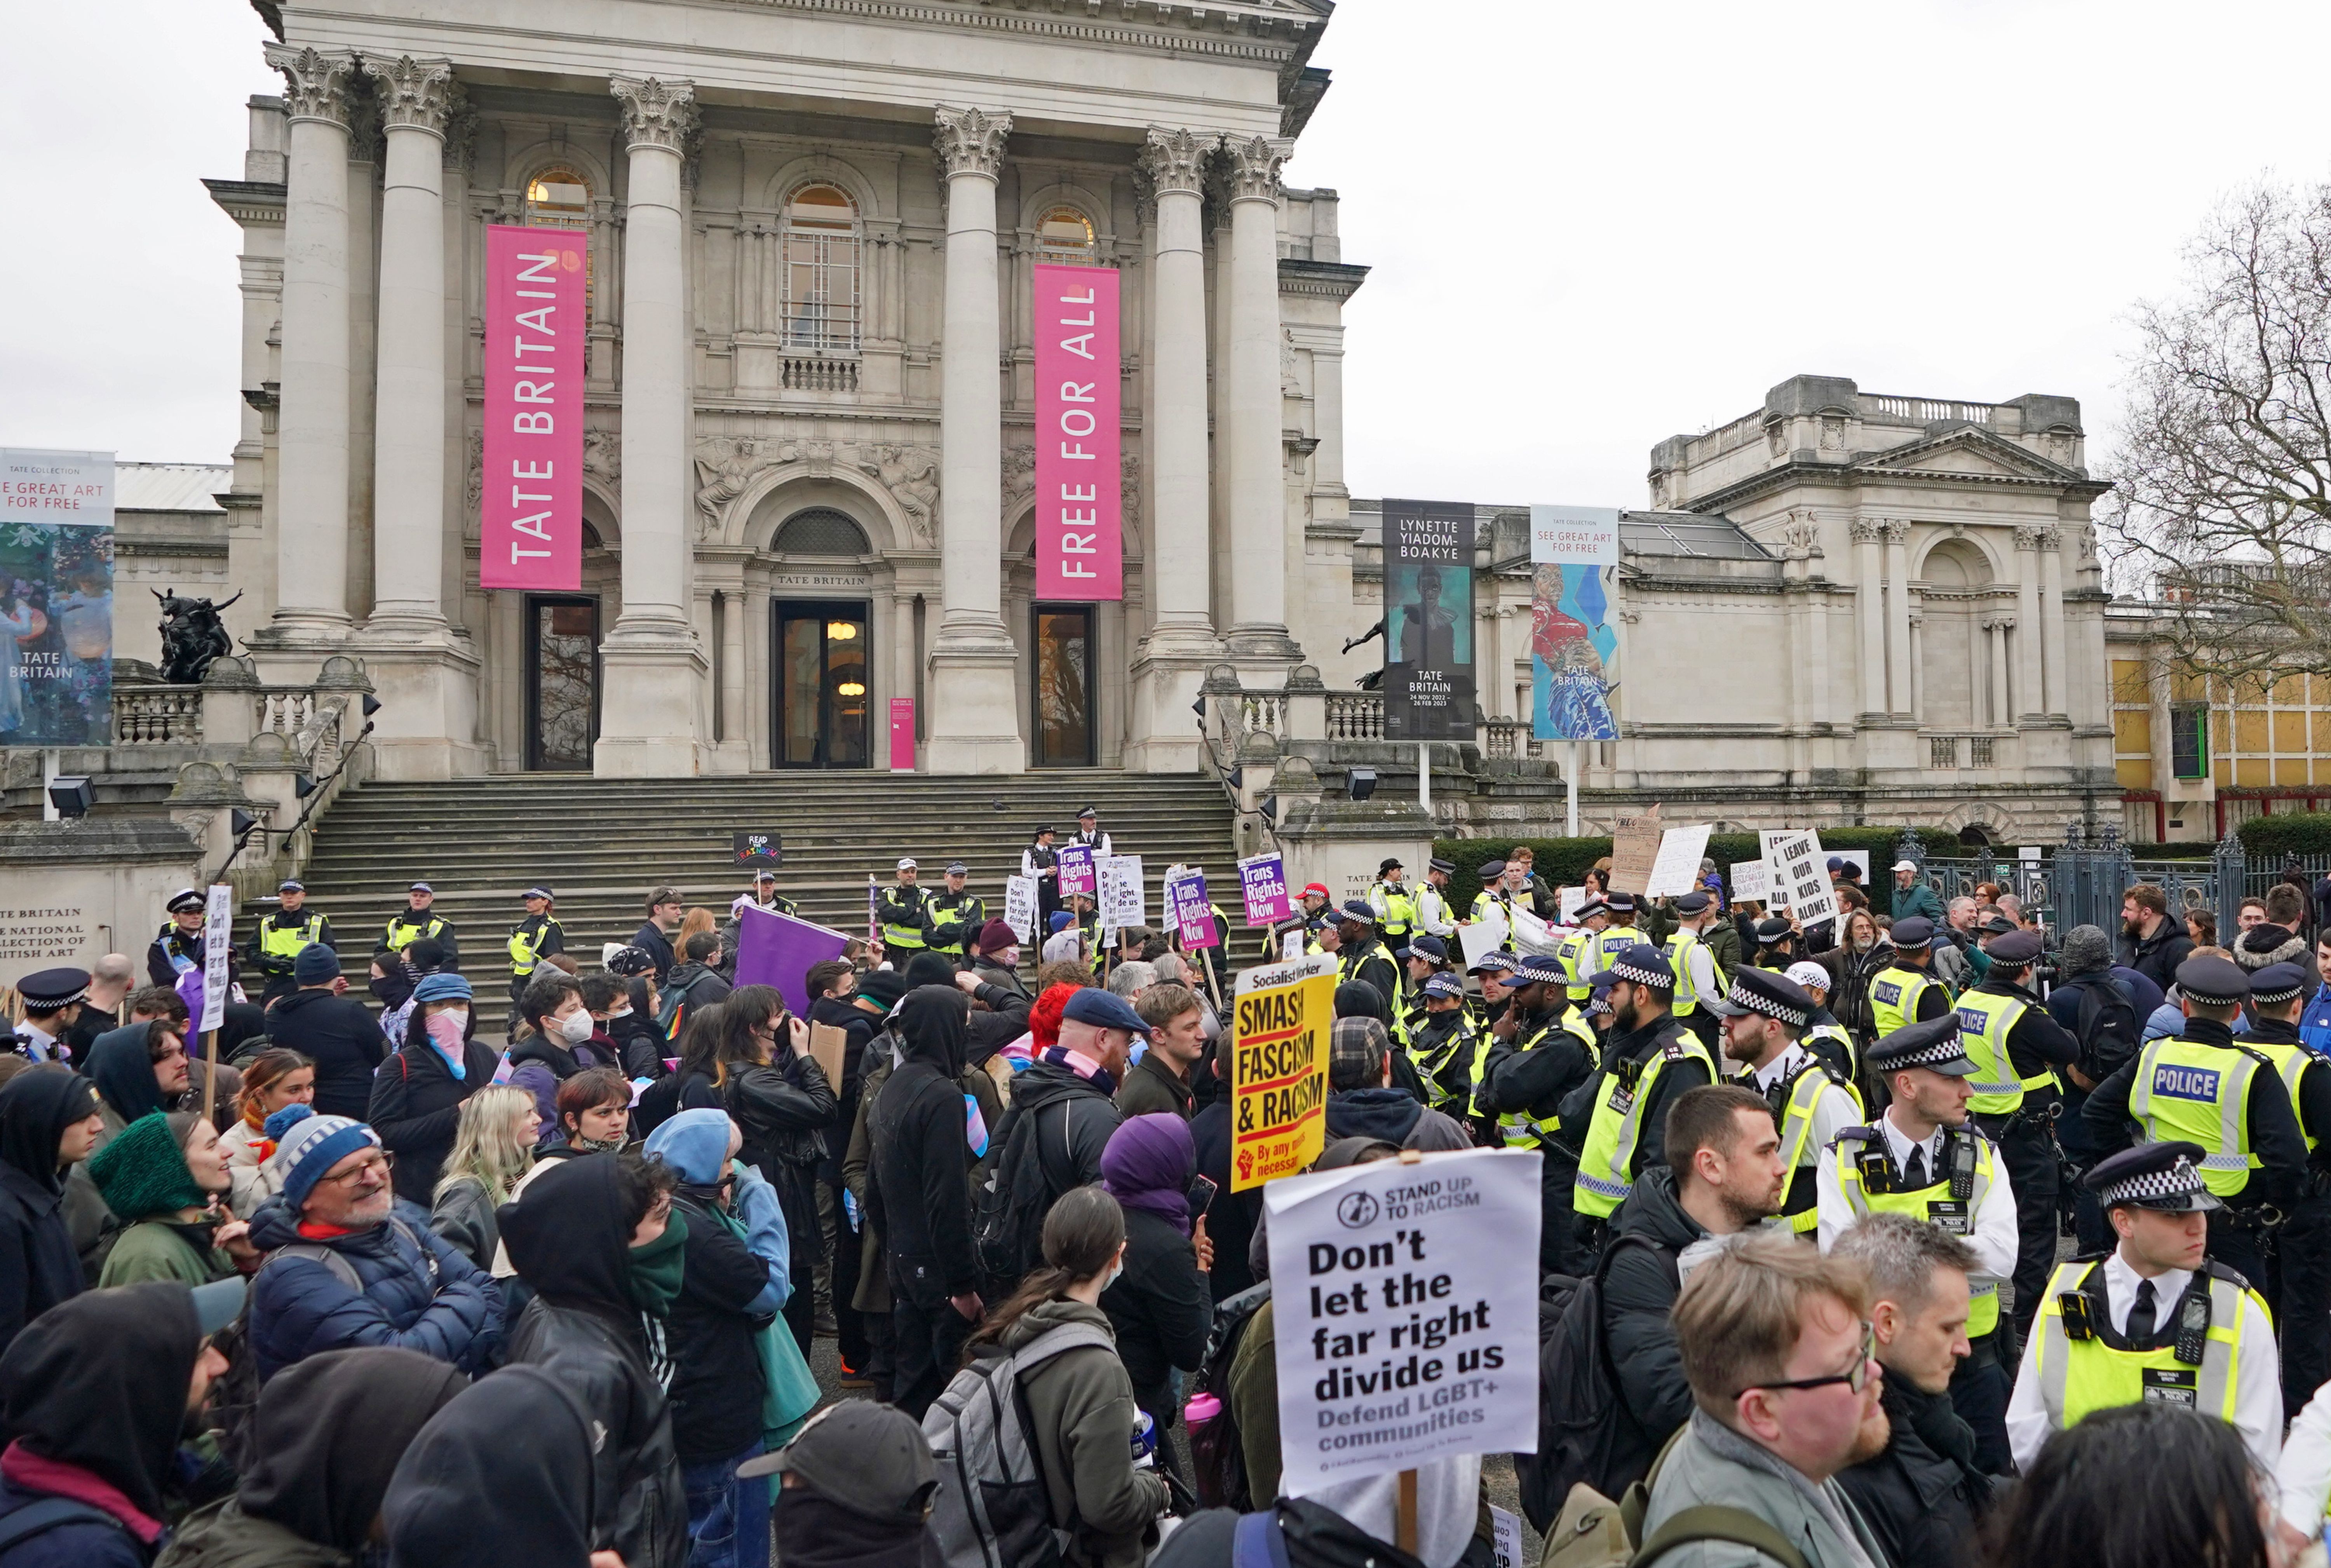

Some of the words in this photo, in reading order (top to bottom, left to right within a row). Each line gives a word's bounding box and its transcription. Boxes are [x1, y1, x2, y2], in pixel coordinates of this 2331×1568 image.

[1060, 288, 1095, 360] ALL
[513, 253, 557, 435] BRITAIN
[1060, 381, 1096, 460] FOR
[17, 483, 67, 495] GREAT
[74, 485, 103, 497] ART
[8, 496, 37, 508] FOR
[45, 498, 80, 510] FREE
[511, 460, 553, 565] TATE
[1061, 483, 1097, 578] FREE
[1401, 519, 1457, 533] LYNETTE
[1400, 532, 1458, 546] YIADOM-
[1538, 531, 1554, 540] SEE
[1558, 531, 1589, 542] GREAT
[1593, 533, 1611, 542] ART
[1401, 546, 1458, 559] BOAKYE
[1553, 543, 1571, 552] FOR
[1576, 544, 1598, 553] FREE
[814, 577, 865, 585] BRITAIN
[23, 652, 59, 664] TATE
[10, 666, 72, 678] BRITAIN
[1418, 671, 1442, 680] TATE
[1566, 665, 1588, 675] TATE
[1409, 682, 1450, 692] BRITAIN
[1558, 676, 1597, 685] BRITAIN
[749, 836, 768, 844] READ
[739, 847, 777, 859] RAINBOW
[1057, 850, 1085, 864] Trans
[1784, 839, 1811, 861] LEAVE
[1060, 862, 1092, 881] Rights
[1240, 866, 1274, 883] Trans
[1792, 861, 1812, 880] OUR
[1061, 879, 1082, 894] Now
[1120, 889, 1135, 899] ight
[1173, 882, 1199, 901] Trans
[1246, 880, 1285, 902] Rights
[1797, 879, 1821, 899] KIDS
[19, 908, 81, 918] BRITAIN
[1178, 899, 1209, 924] Rights
[1249, 901, 1274, 919] Now
[1798, 899, 1826, 921] ALONE
[10, 925, 84, 935] NATIONAL
[1182, 922, 1204, 942] Now
[47, 948, 76, 957] ART
[1605, 939, 1634, 951] POLICE
[1253, 971, 1295, 988] Socialist
[1296, 963, 1321, 980] Worker
[1877, 983, 1899, 1003] POLICE
[1239, 988, 1303, 1036] SMASH
[1239, 1030, 1314, 1085] FASCISM
[2156, 1069, 2215, 1097] POLICE
[1238, 1098, 1254, 1133] &
[1264, 1072, 1323, 1127] RACISM
[1258, 1145, 1270, 1162] By
[1274, 1143, 1289, 1157] any
[1386, 1181, 1441, 1204] STAND
[1447, 1178, 1472, 1190] UP
[1387, 1207, 1408, 1221] TO
[1413, 1192, 1480, 1216] RACISM
[1309, 1230, 1425, 1276] Don't
[1310, 1283, 1368, 1319] let
[1382, 1273, 1451, 1308] the
[1312, 1328, 1375, 1361] far
[1391, 1300, 1490, 1350] right
[1315, 1355, 1444, 1402] divide
[1458, 1345, 1504, 1373] us
[1317, 1397, 1410, 1429] Defend
[1418, 1379, 1498, 1412] LGBT+
[1319, 1408, 1484, 1452] communities
